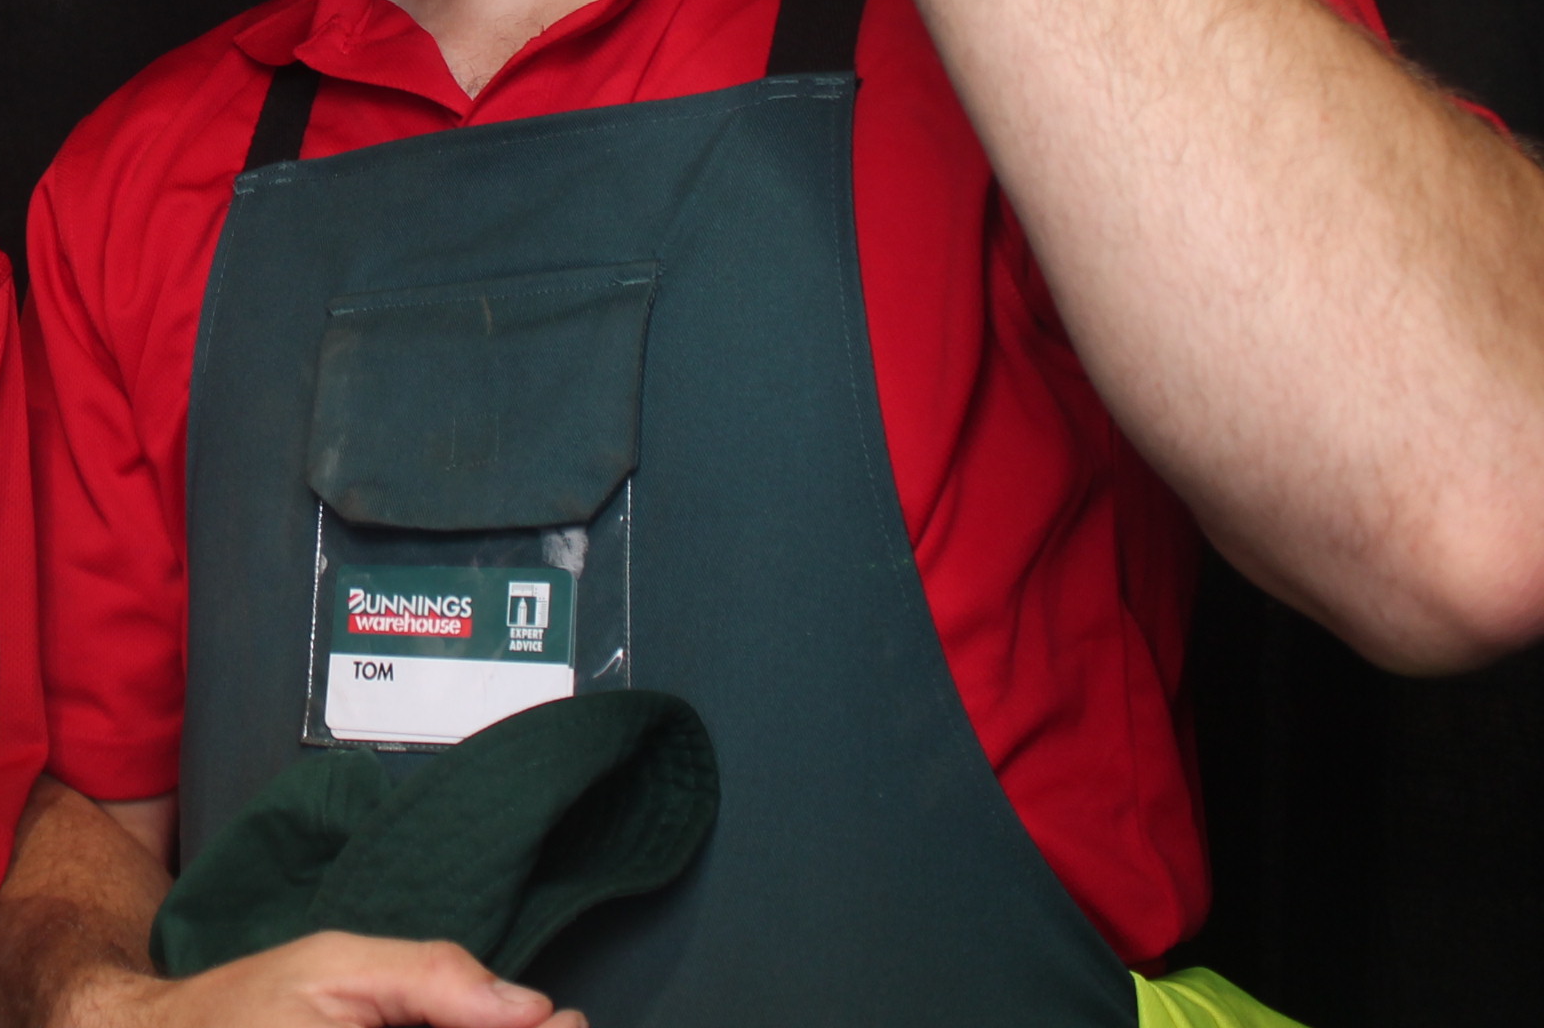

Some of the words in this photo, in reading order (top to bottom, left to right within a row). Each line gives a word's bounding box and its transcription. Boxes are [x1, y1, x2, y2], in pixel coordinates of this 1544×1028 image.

[348, 589, 472, 618] BUNNINGS
[355, 612, 462, 635] warehouse
[509, 628, 543, 640] EXPERT
[509, 640, 543, 652] ADVICE
[353, 661, 394, 681] TOM
